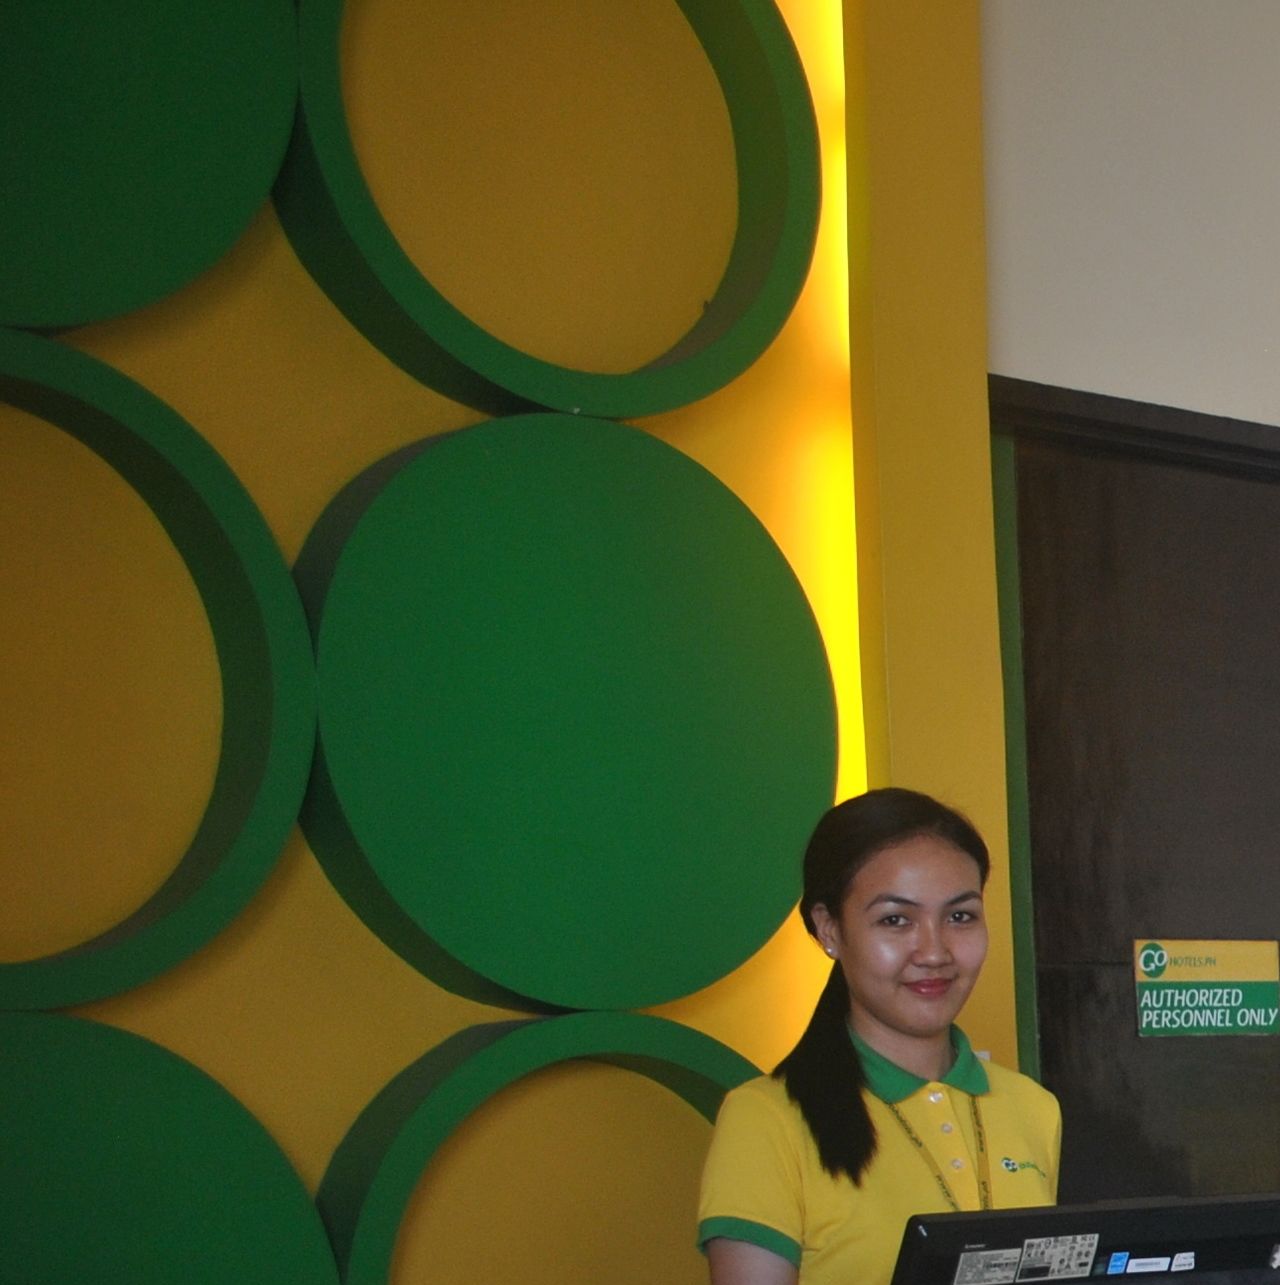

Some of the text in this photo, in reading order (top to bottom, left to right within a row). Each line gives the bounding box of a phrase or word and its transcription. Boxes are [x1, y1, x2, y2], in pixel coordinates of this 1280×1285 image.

[1141, 988, 1243, 1008] AUTHORIZED
[1142, 1008, 1279, 1029] PERSONNEL ONLY
